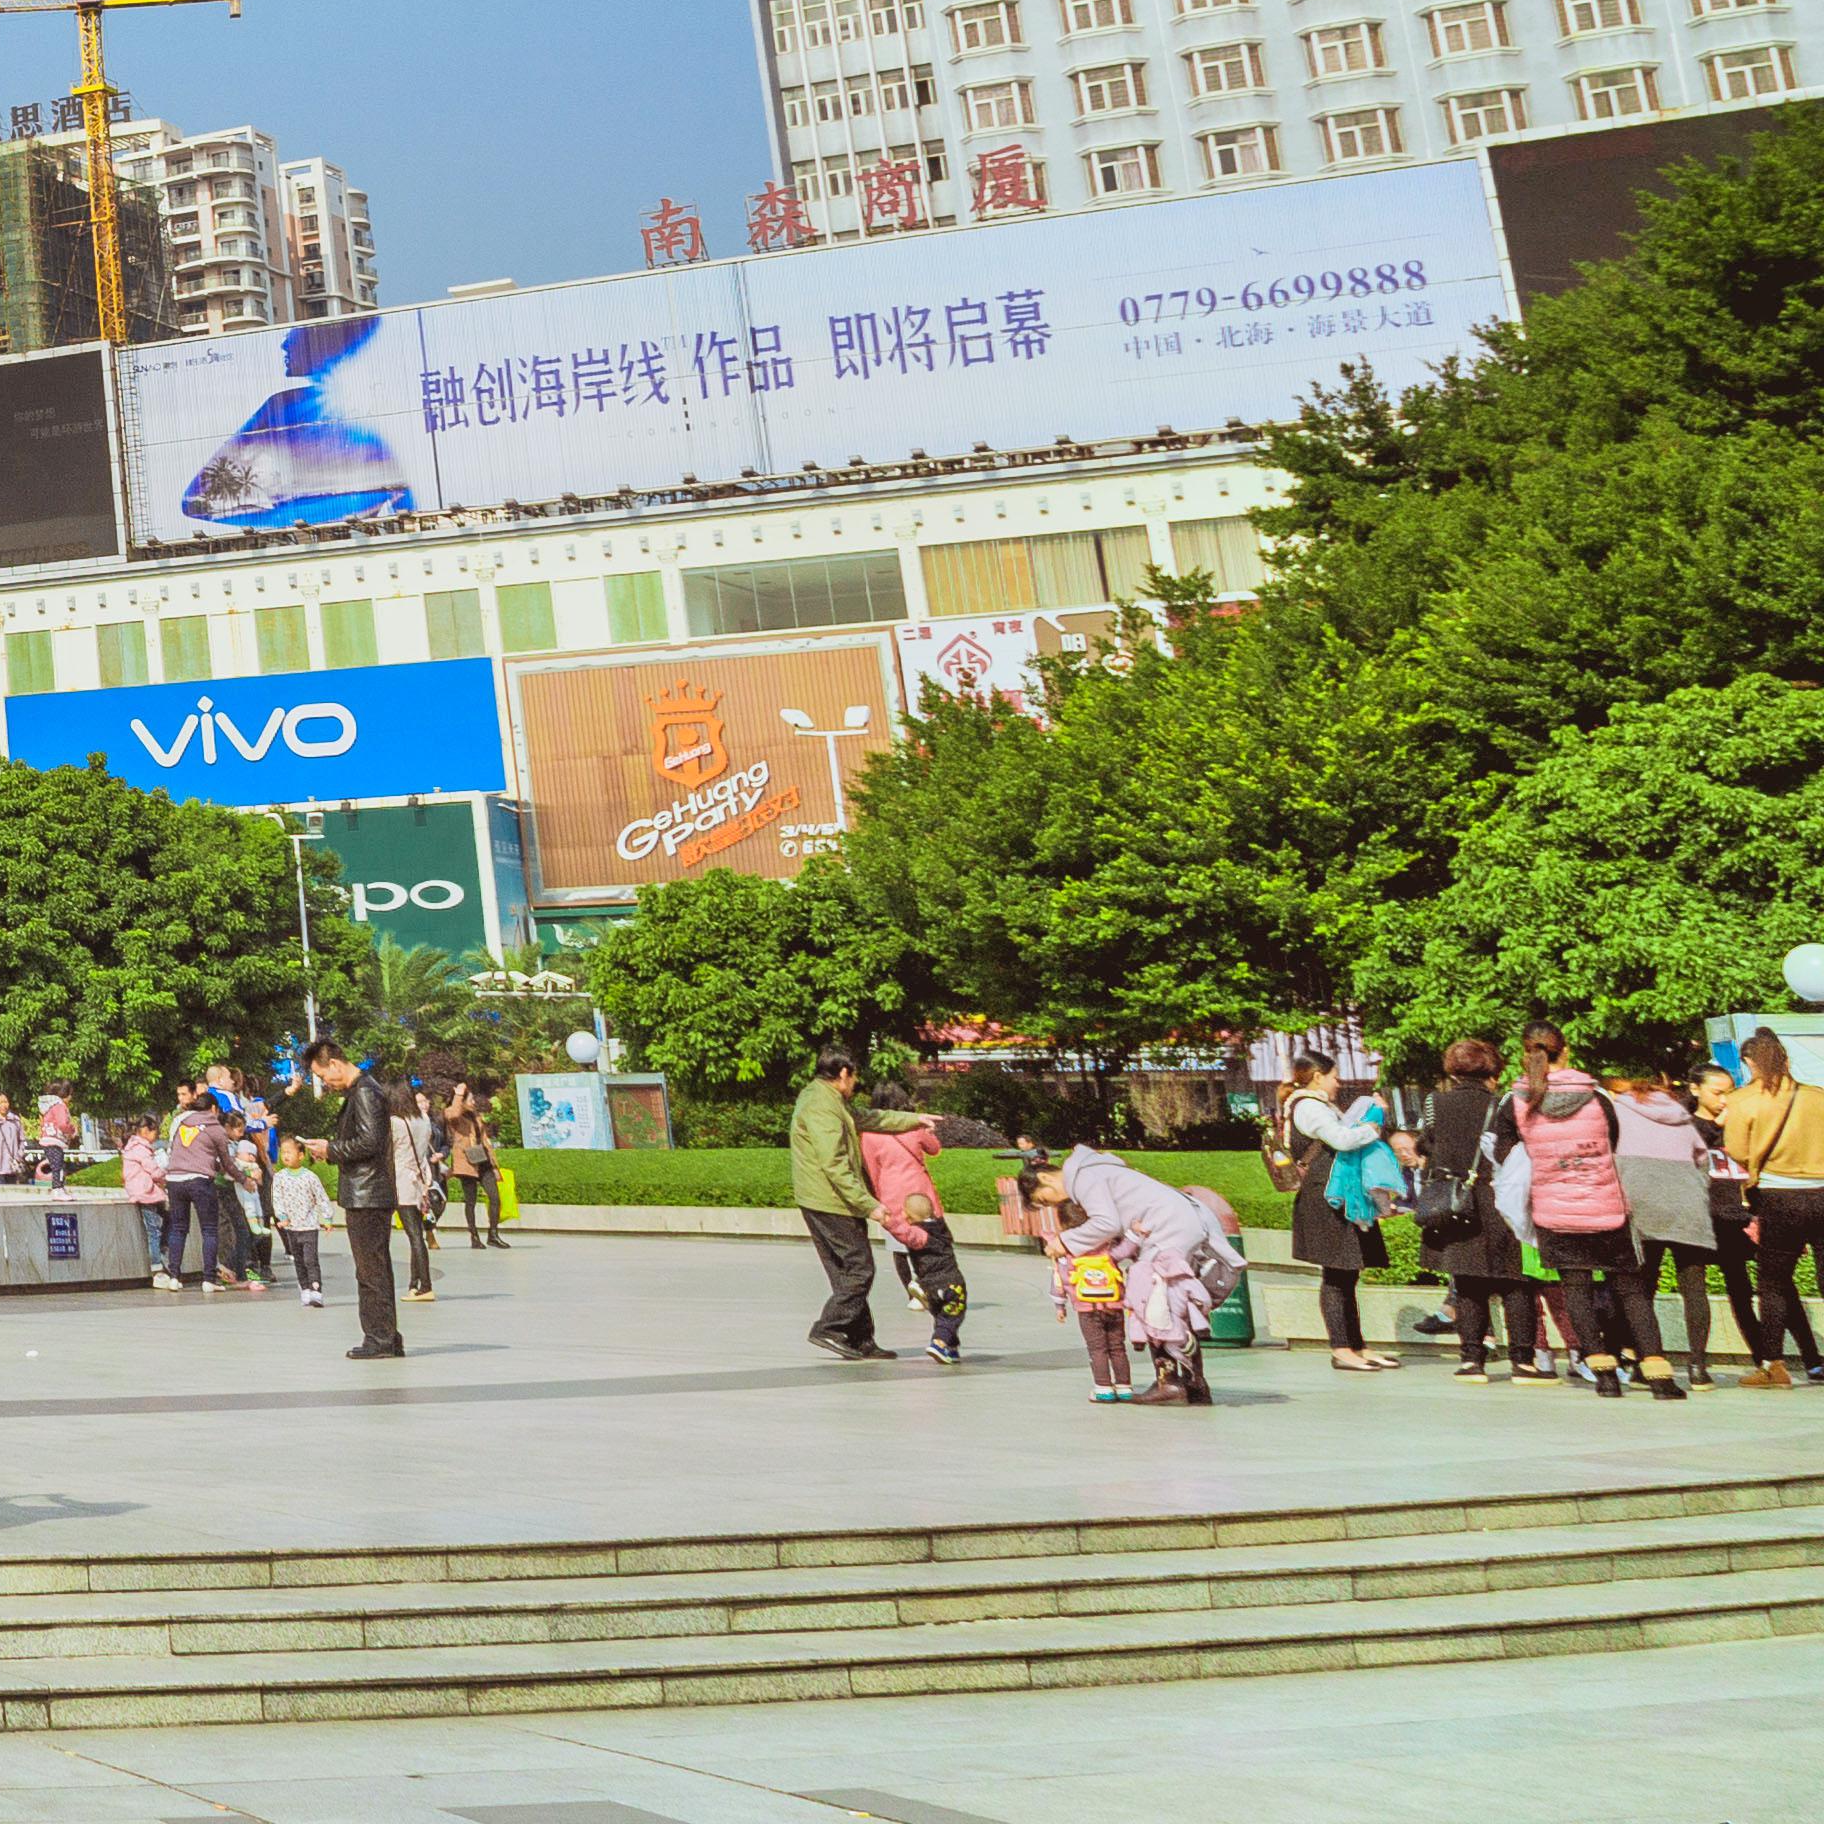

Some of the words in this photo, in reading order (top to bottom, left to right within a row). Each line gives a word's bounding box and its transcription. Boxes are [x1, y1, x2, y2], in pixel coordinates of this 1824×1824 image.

[640, 143, 1047, 260] 南森商厦
[1119, 259, 1429, 327] 0779-6699888
[418, 340, 671, 434] 融创海岸线
[692, 323, 796, 401] 作品
[826, 288, 1054, 382] 即将启幕
[129, 695, 358, 769] vivo
[663, 741, 713, 771] GeHuang
[616, 760, 770, 862] GeHuang
[661, 787, 765, 858] Party
[336, 879, 465, 922] po
